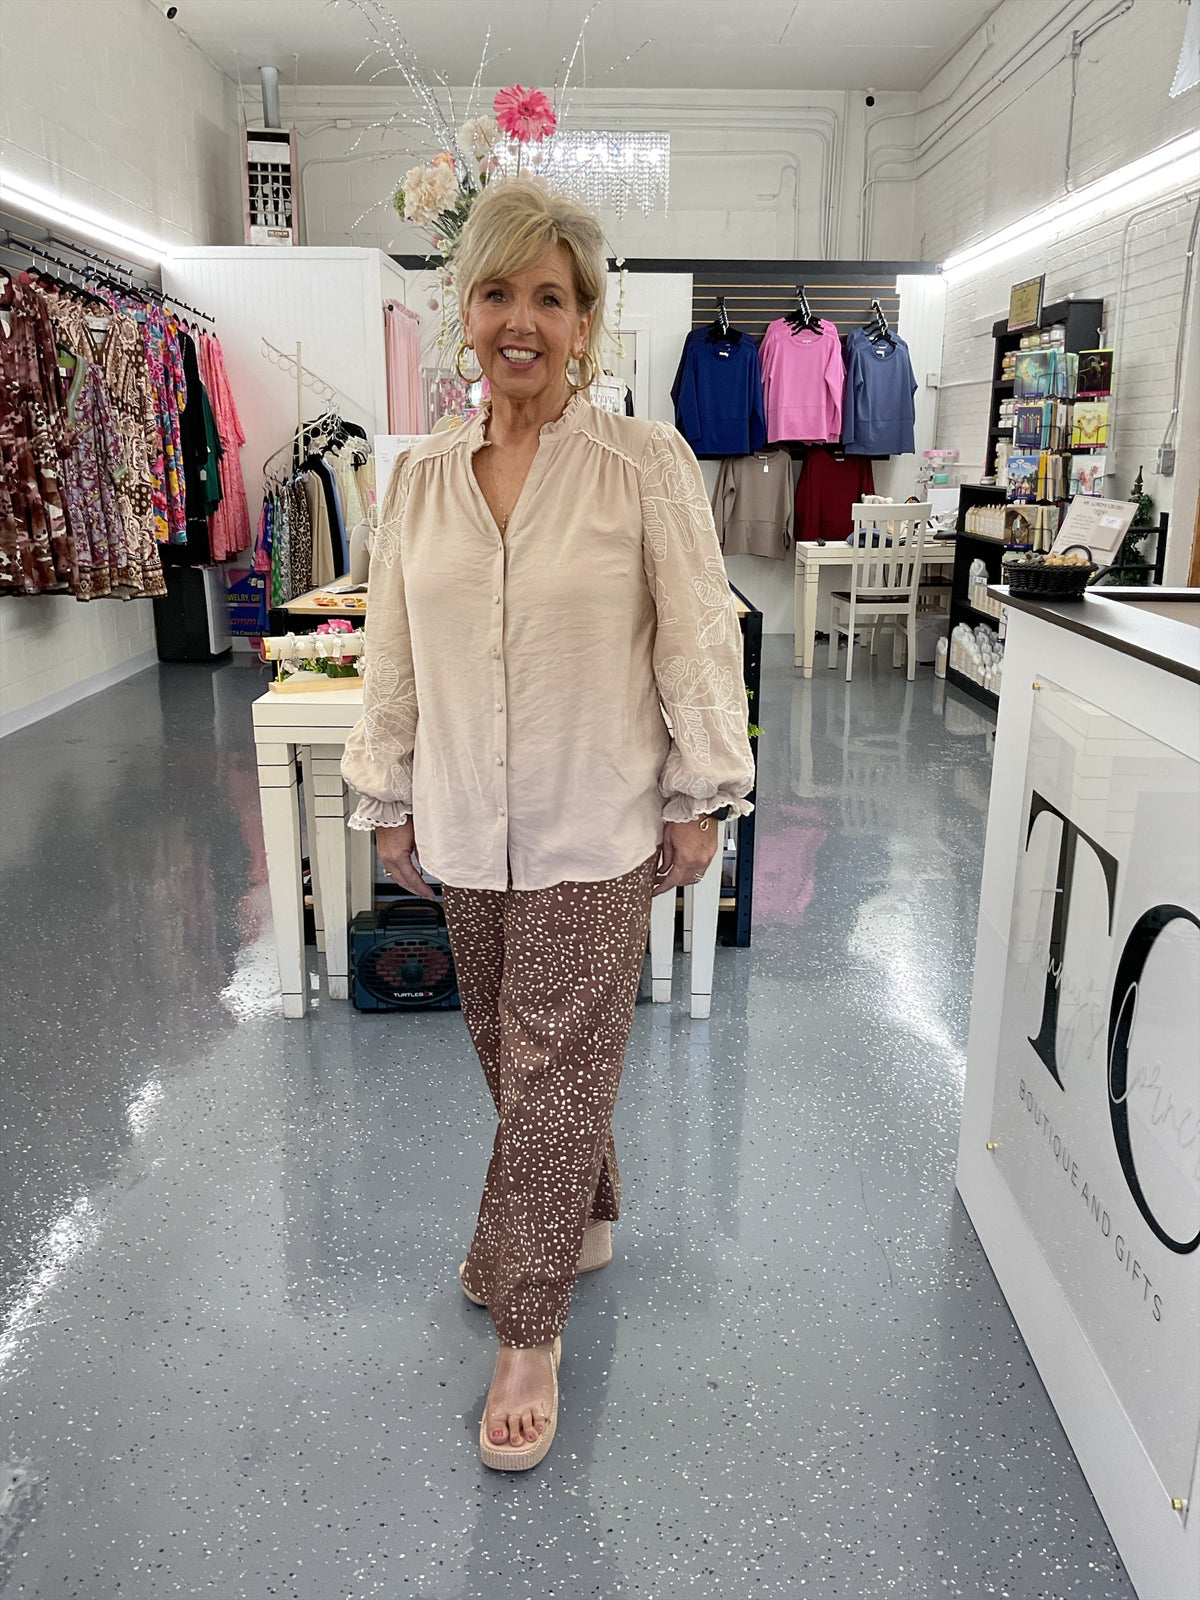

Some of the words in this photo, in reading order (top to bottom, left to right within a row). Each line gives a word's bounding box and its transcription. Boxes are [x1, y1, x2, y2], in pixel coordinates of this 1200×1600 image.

[1018, 1078, 1079, 1188] BOUTIQUE
[1080, 1181, 1111, 1237] AND
[1114, 1234, 1163, 1322] GIFTS
